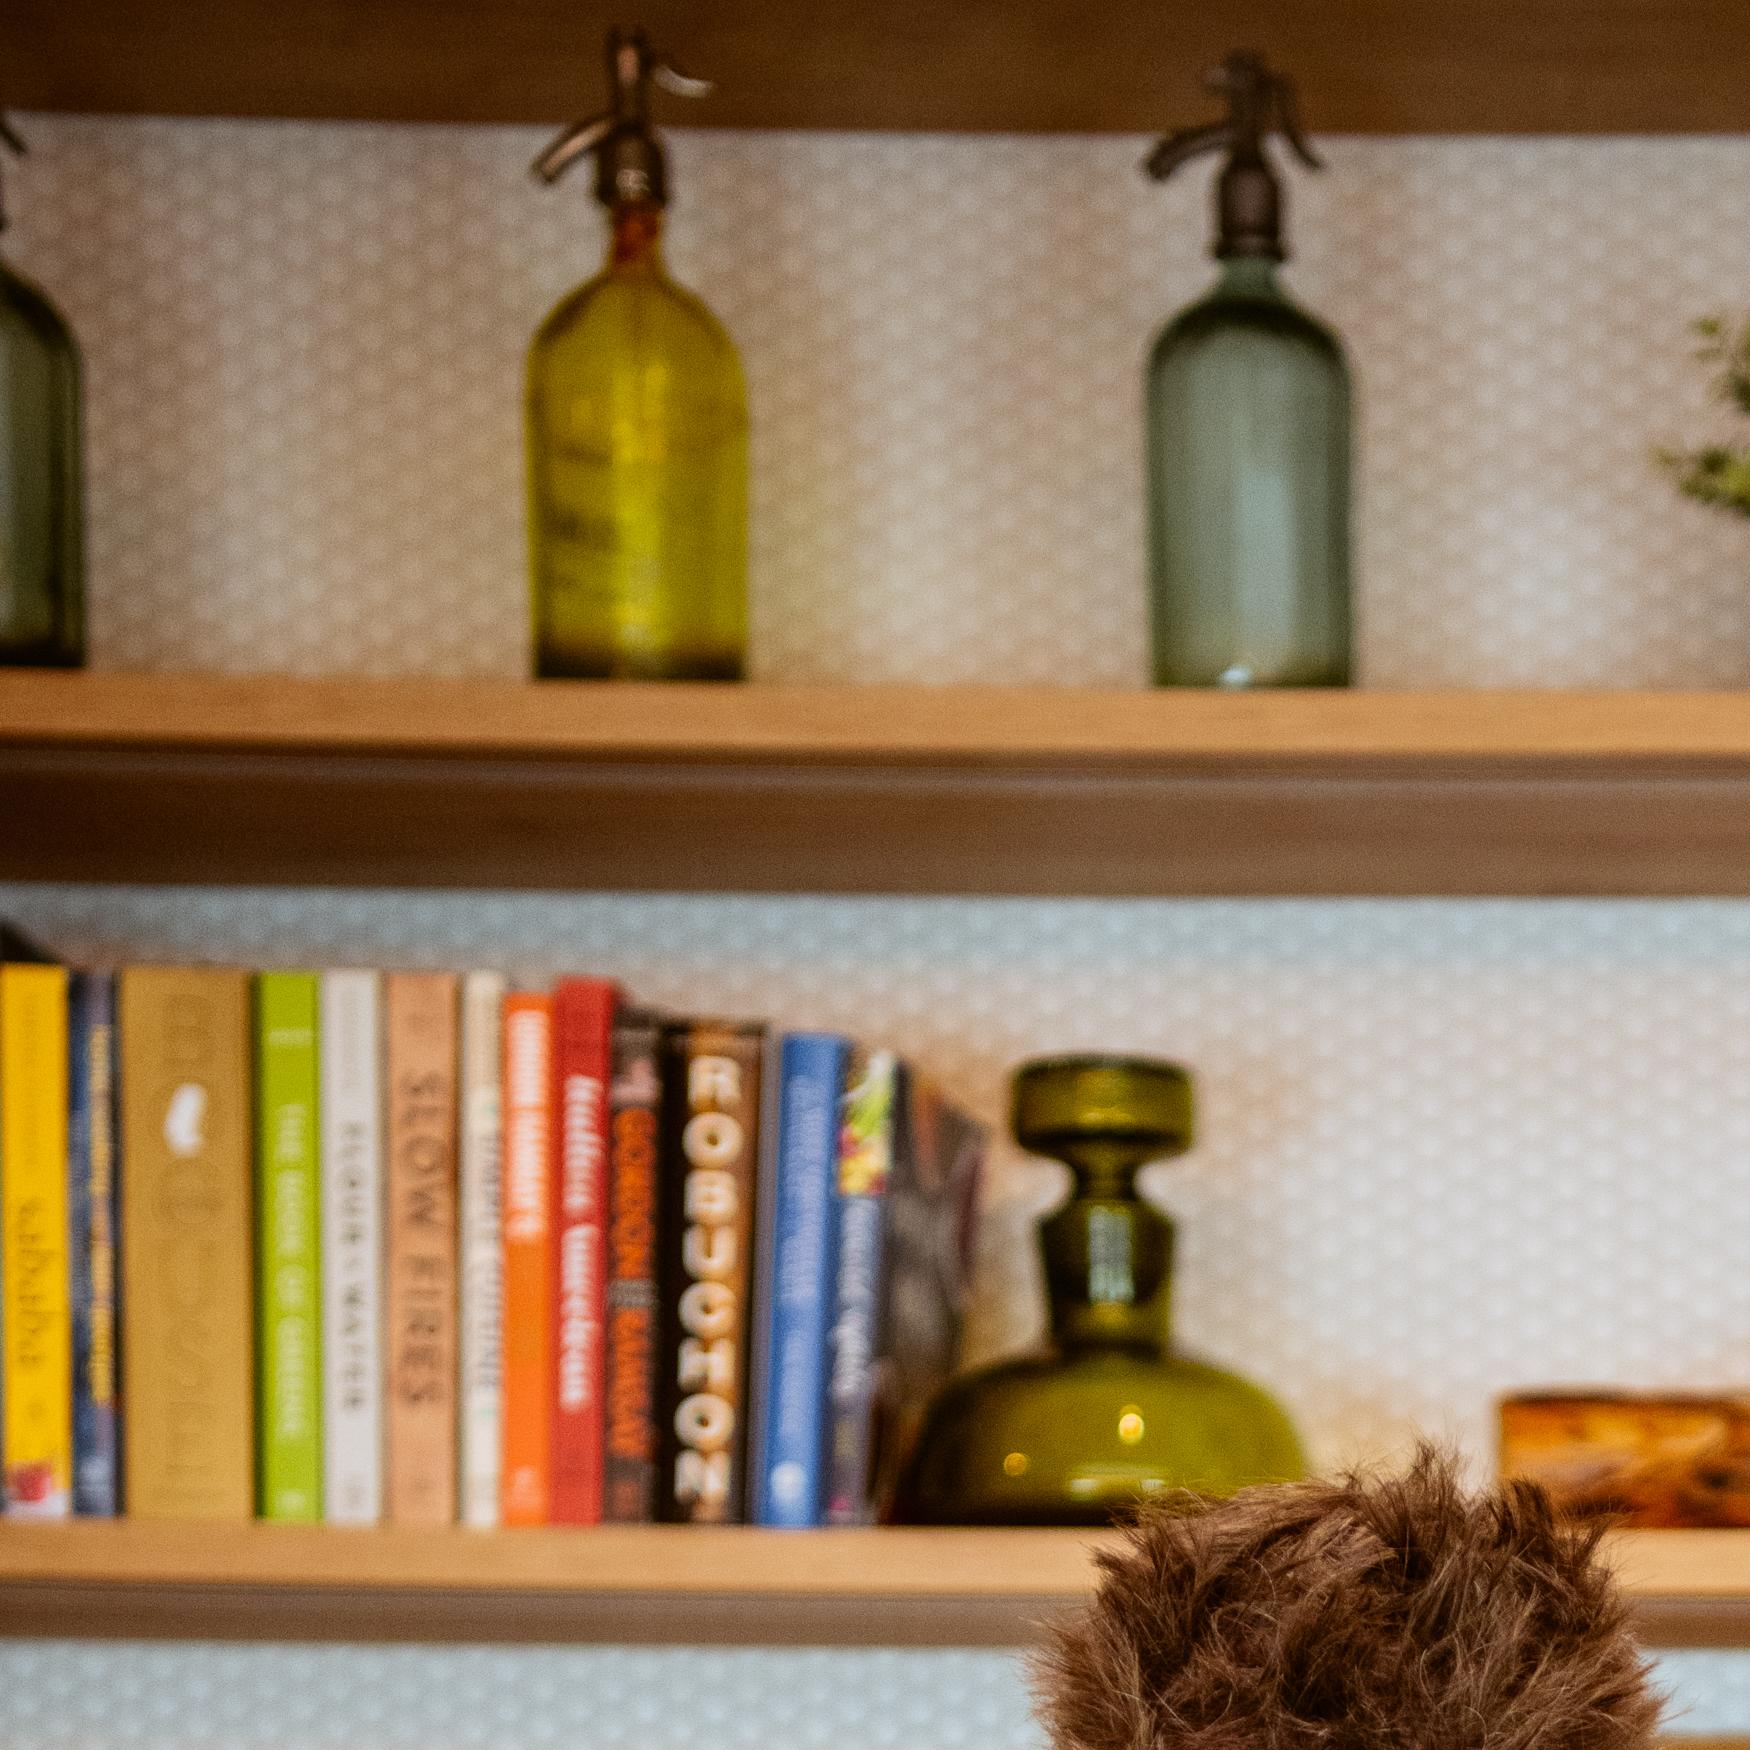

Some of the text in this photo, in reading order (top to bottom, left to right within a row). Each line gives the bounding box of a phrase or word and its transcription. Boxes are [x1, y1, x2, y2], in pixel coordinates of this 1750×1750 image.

[404, 1070, 445, 1234] SLOW
[401, 1253, 444, 1405] FIRES
[674, 1055, 744, 1508] ROBUCHON
